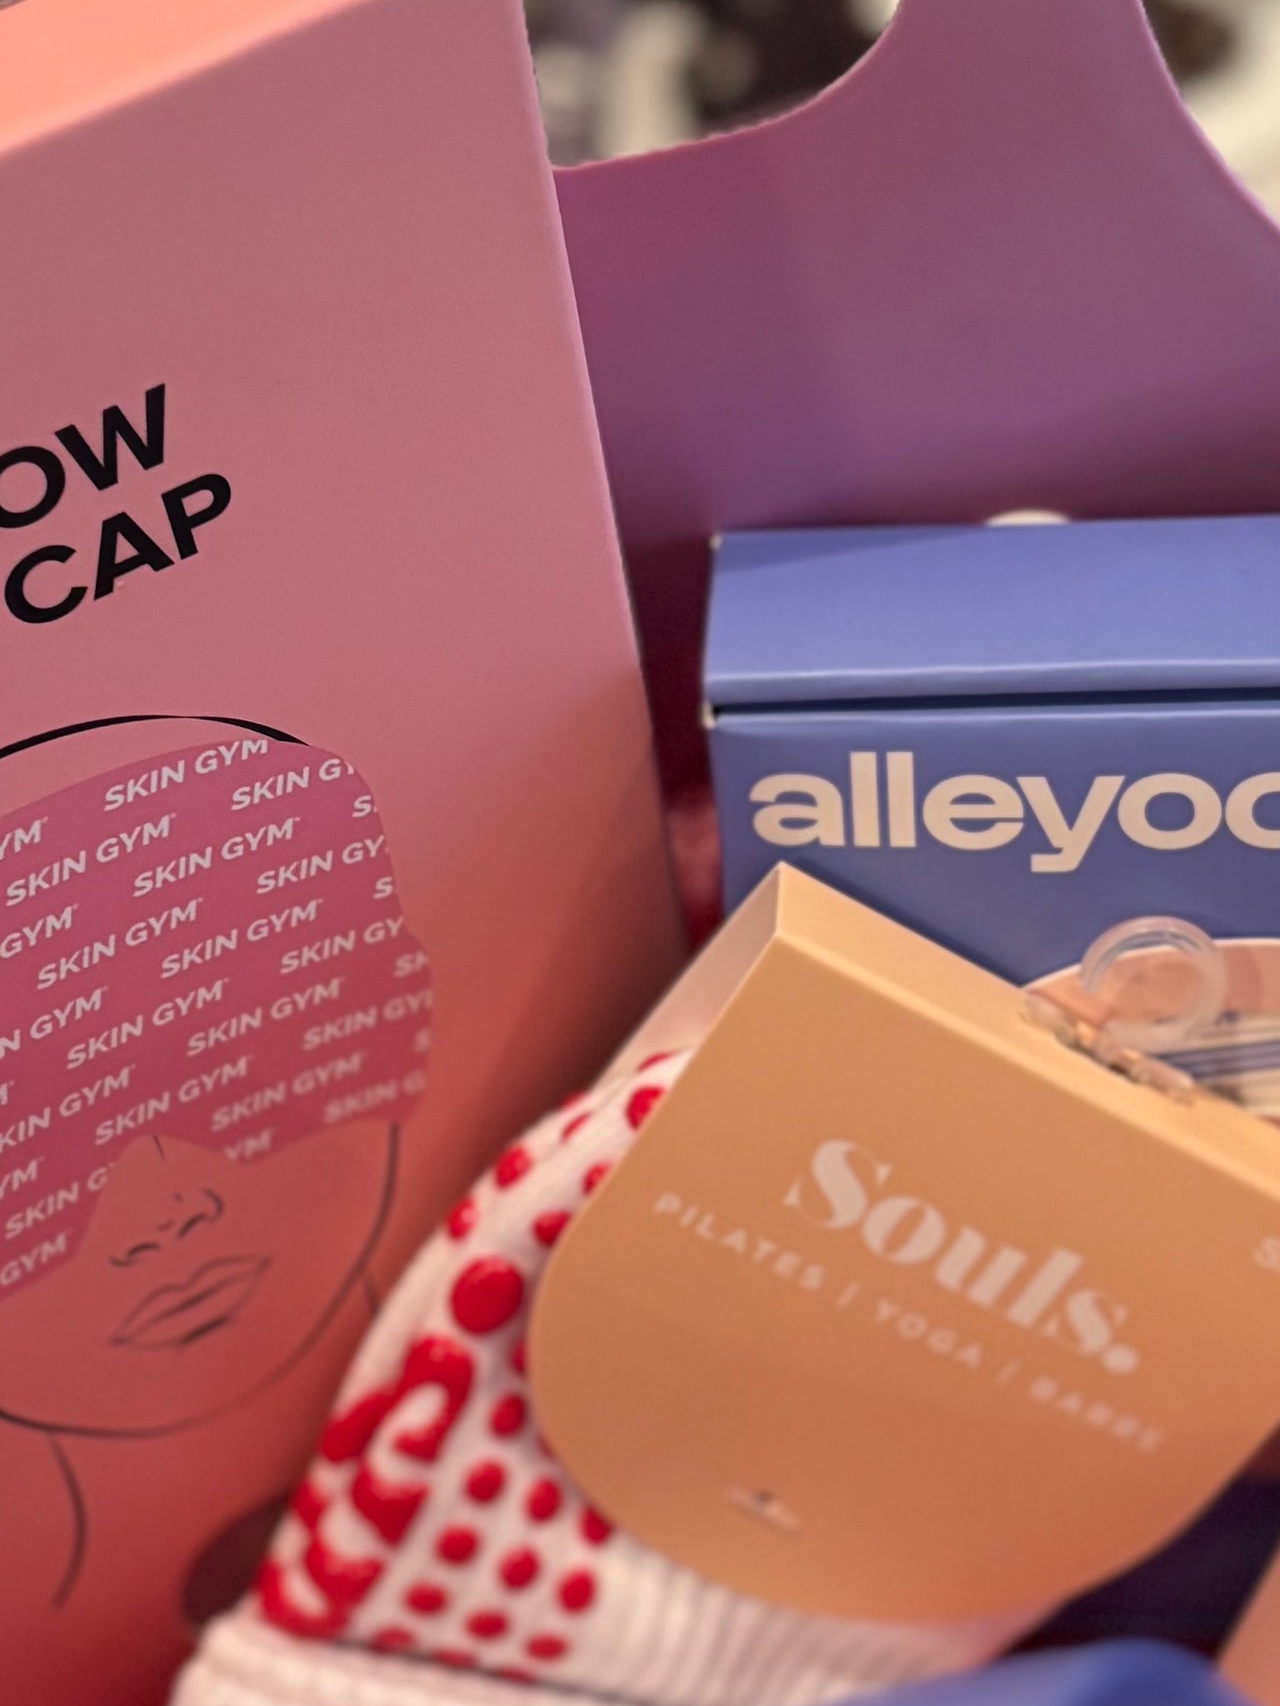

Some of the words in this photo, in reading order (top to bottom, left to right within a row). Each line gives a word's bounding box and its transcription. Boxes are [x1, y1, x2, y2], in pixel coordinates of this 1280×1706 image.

[4, 473, 232, 625] CAP
[104, 760, 186, 811] SKIN
[194, 739, 269, 775] GYM
[230, 767, 310, 811] SKIN
[5, 850, 87, 907] SKIN
[95, 814, 171, 864] GYM
[132, 846, 213, 898] SKIN
[221, 817, 294, 861] GYM
[256, 851, 334, 895] SKIN
[342, 834, 389, 865] GY
[37, 934, 116, 990] SKIN
[124, 899, 197, 947] GYM
[161, 929, 239, 979] SKIN
[246, 899, 318, 942] GYM
[279, 930, 356, 974] SKIN
[363, 916, 404, 945] GY
[29, 989, 102, 1040] GYM
[66, 1015, 144, 1070] SKIN
[151, 980, 224, 1027] GYM
[186, 1007, 263, 1057] SKIN
[269, 978, 342, 1021] GYM
[382, 992, 434, 1022] GY
[58, 1067, 130, 1118] GYM
[94, 1092, 170, 1145] SKIN
[177, 1056, 250, 1103] GYM
[4, 1182, 80, 1240] SKIN
[652, 1191, 826, 1293] PILATES
[875, 1300, 984, 1372] YOGA
[1027, 1375, 1169, 1455] BARRE
